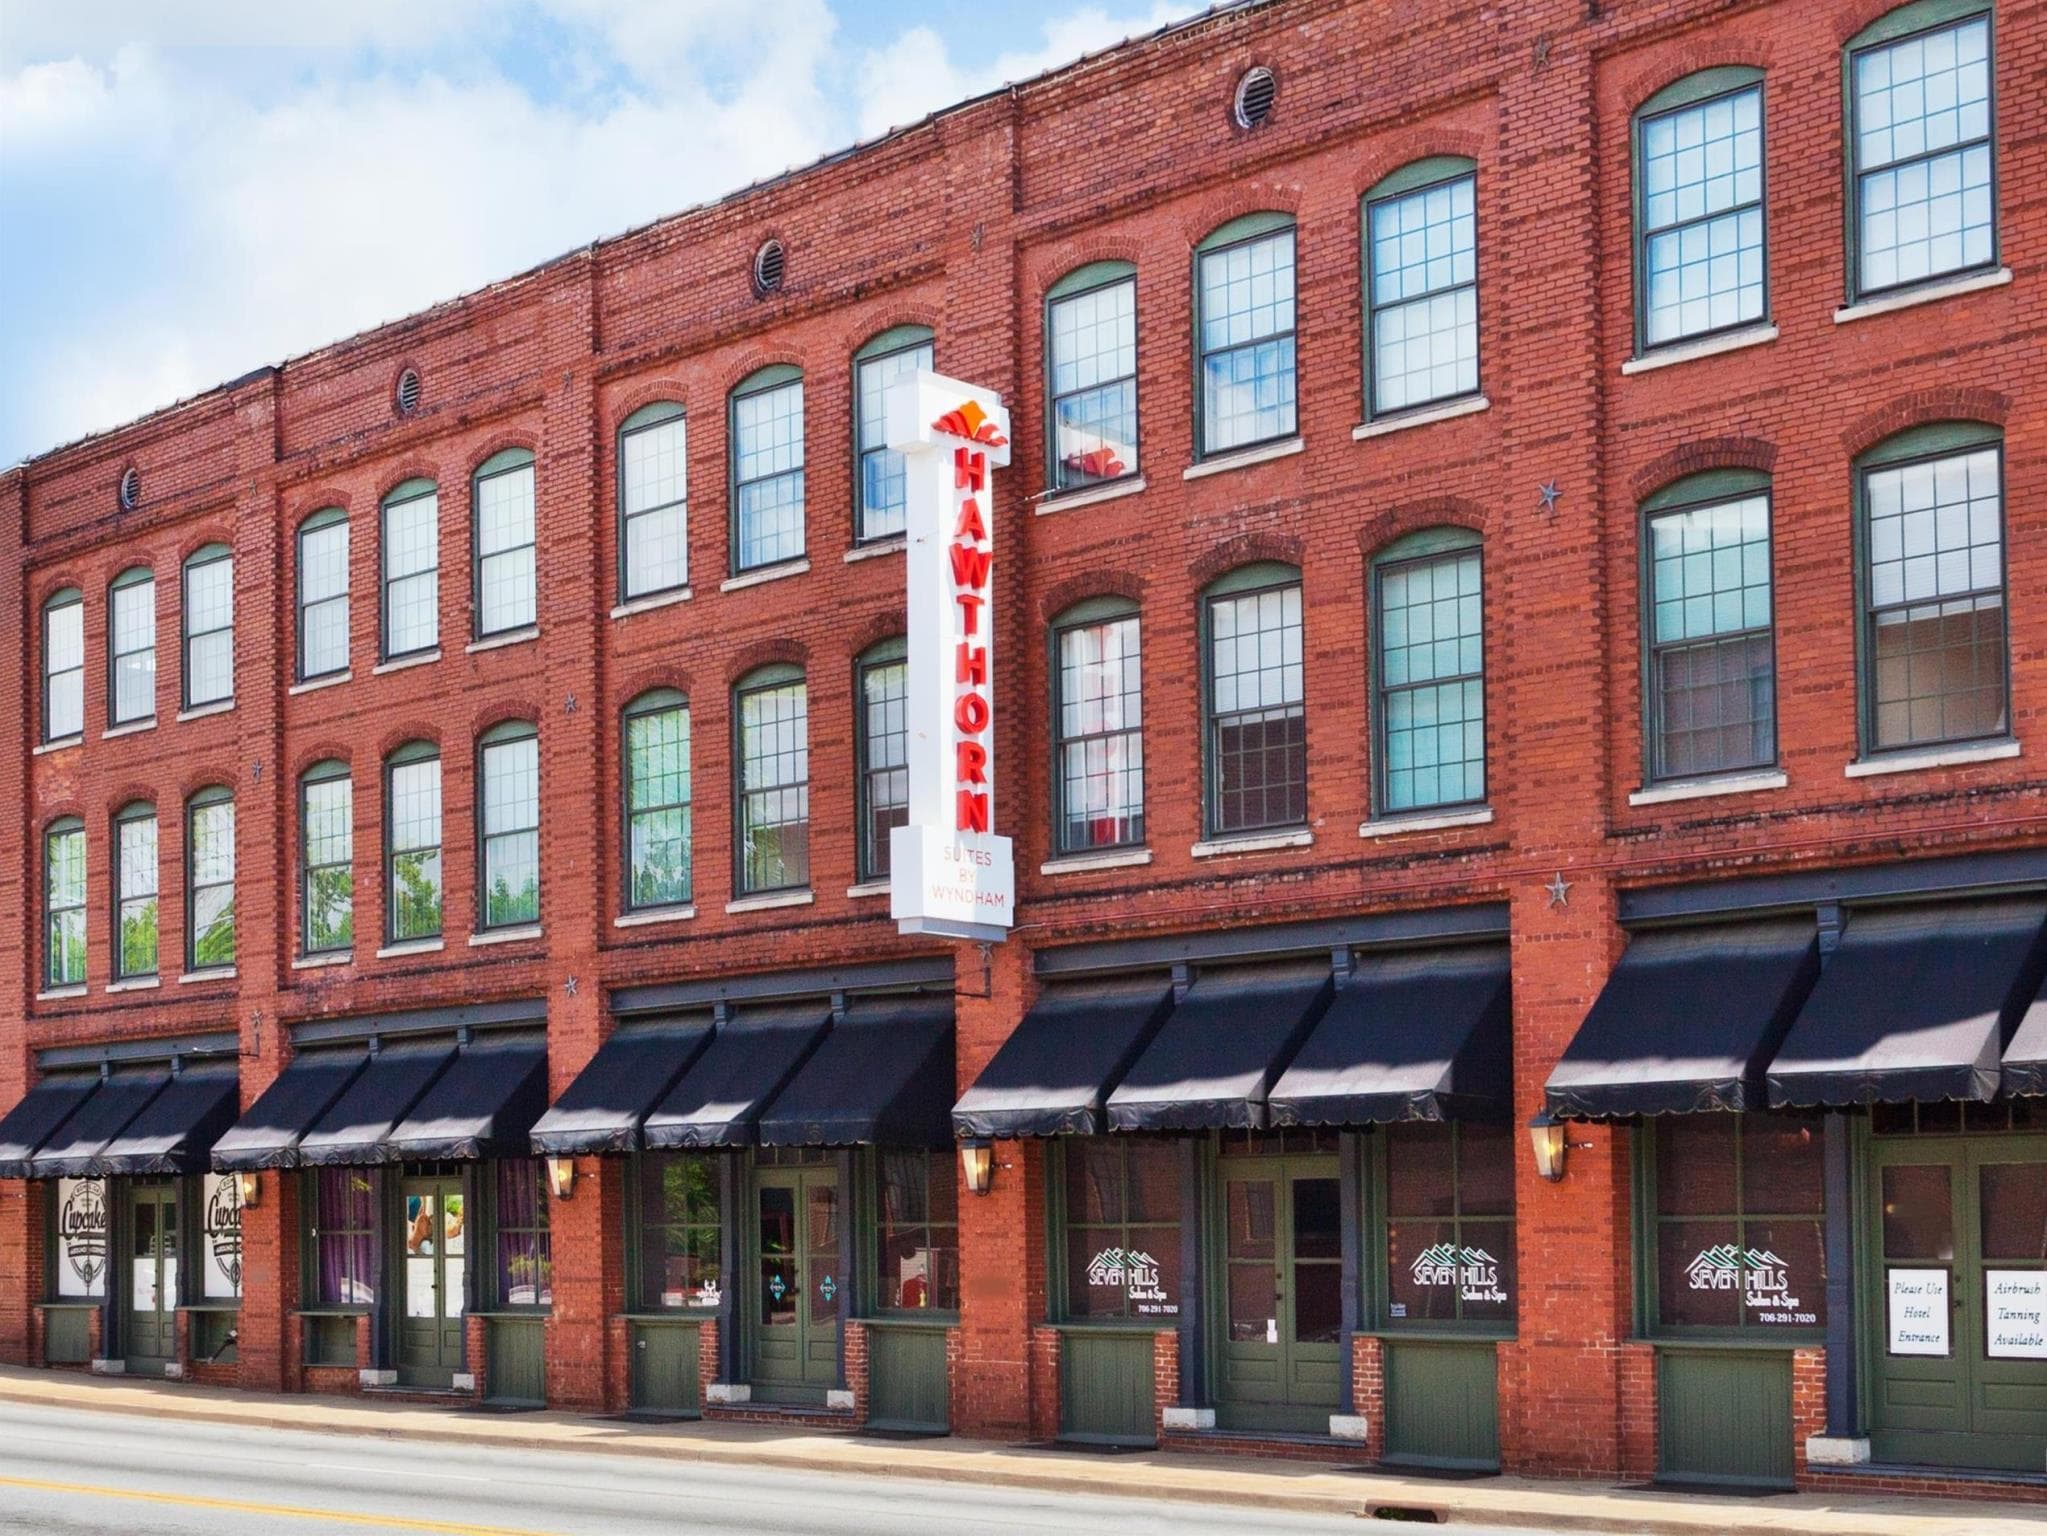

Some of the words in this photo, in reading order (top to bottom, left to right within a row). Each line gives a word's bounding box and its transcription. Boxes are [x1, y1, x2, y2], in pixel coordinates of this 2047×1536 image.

[949, 446, 993, 834] HAWTHORN
[943, 846, 992, 867] SUITES
[959, 868, 976, 883] BY
[932, 884, 1005, 907] WYNDHAM
[207, 1194, 242, 1238] Cupca
[1089, 1267, 1125, 1286] SEVEN
[1128, 1267, 1159, 1286] HILLS
[1413, 1266, 1456, 1285] SEVEN
[1461, 1266, 1498, 1286] HILLS
[1689, 1269, 1739, 1290] SEVEN
[1745, 1269, 1788, 1291] HILLS
[1894, 1281, 1922, 1295] Please
[1926, 1282, 1942, 1295] Use
[1994, 1282, 2041, 1295] Airbrush
[1781, 1291, 1799, 1310] Spa
[1760, 1312, 1816, 1323] 706-291-7020
[1904, 1306, 1930, 1319] Hotel
[1998, 1307, 2041, 1324] Tanning
[1898, 1330, 1941, 1343] Entrance
[1994, 1333, 2044, 1347] Available
